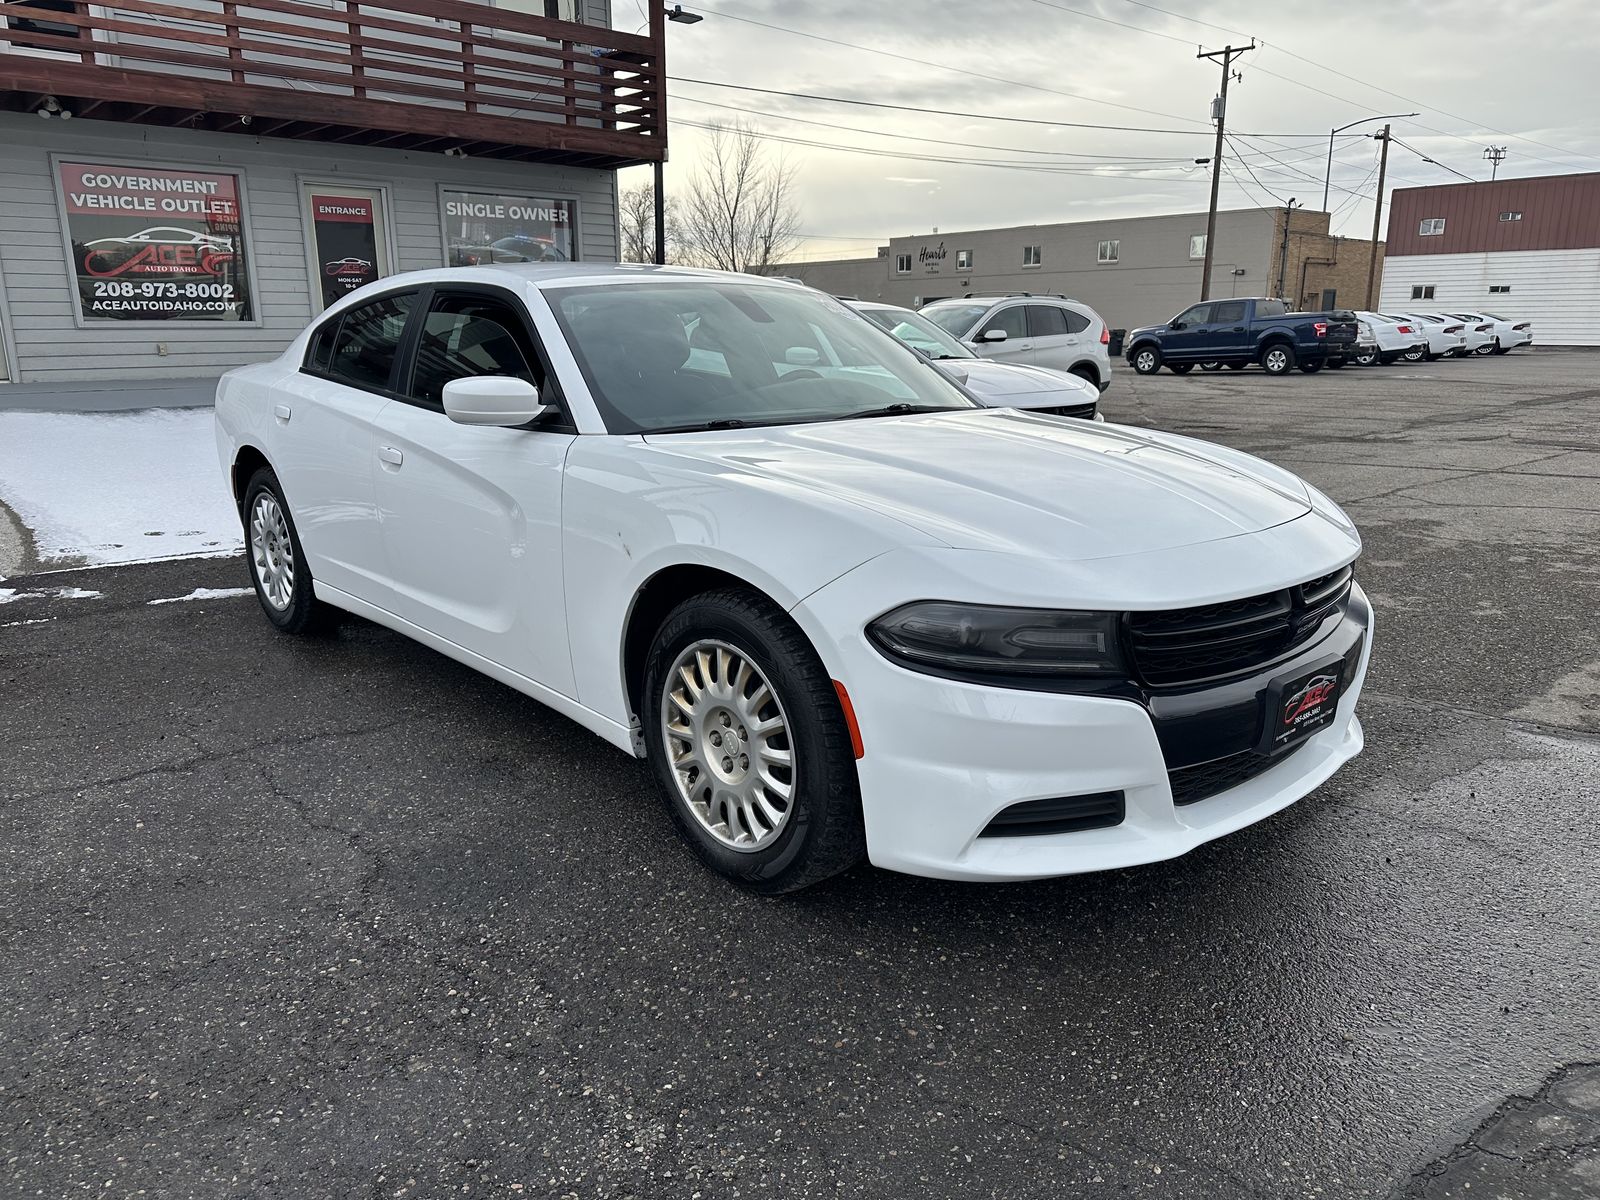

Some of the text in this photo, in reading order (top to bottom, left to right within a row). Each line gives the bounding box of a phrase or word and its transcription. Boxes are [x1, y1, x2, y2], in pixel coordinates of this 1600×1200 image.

[81, 173, 218, 194] GOVERNMENT
[70, 193, 232, 214] VEHICLE OUTLET
[319, 205, 367, 216] ENTRANCE
[446, 202, 569, 223] SINGLE OWNER
[169, 265, 197, 273] IDAHO
[93, 281, 235, 298] 208-973-8002
[92, 300, 236, 311] ACEAUTOIDAHO.COM
